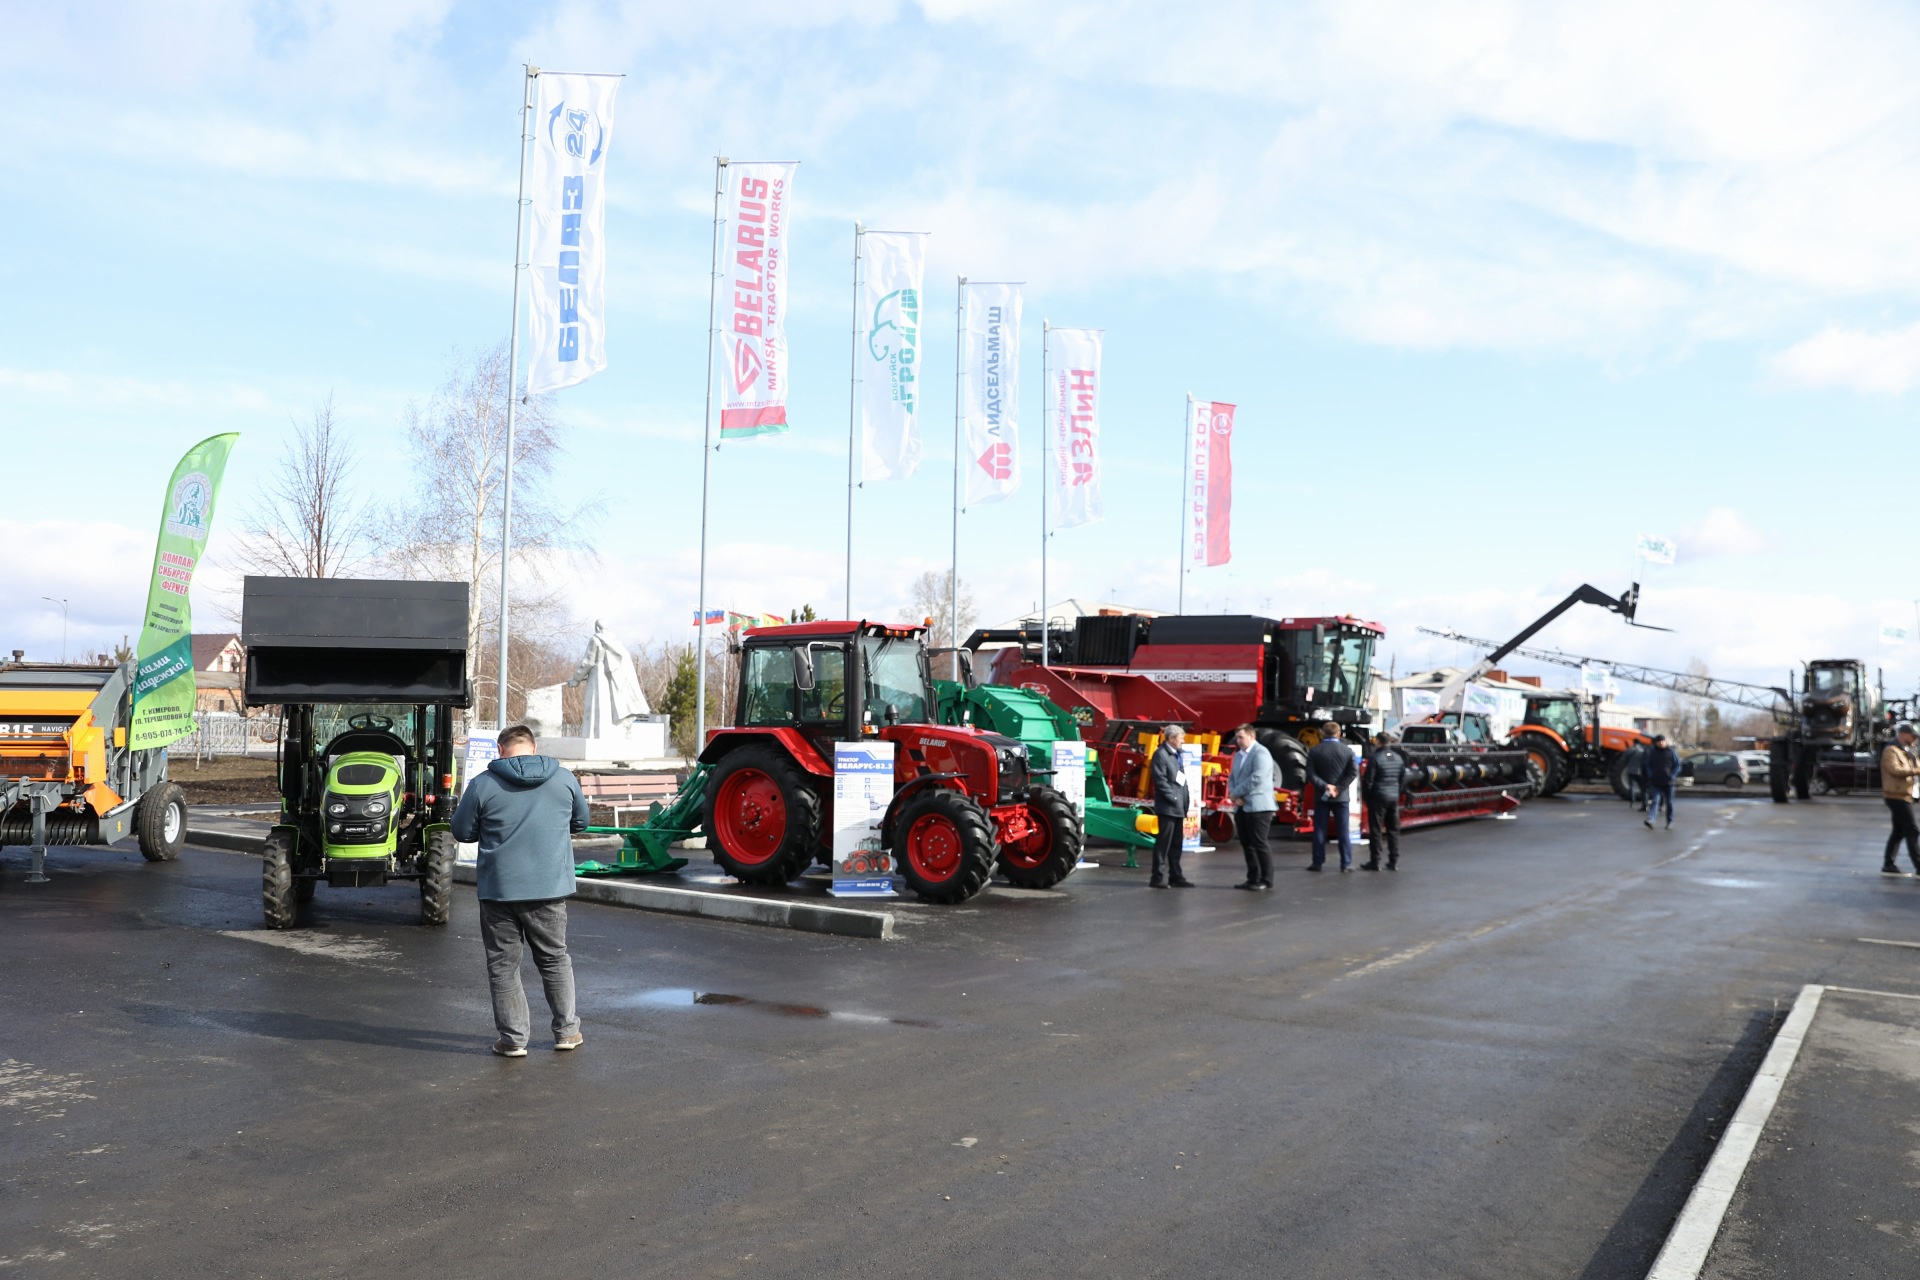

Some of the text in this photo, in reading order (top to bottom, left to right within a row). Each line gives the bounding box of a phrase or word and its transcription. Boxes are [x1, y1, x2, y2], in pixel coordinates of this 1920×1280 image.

[565, 108, 589, 159] 24
[734, 176, 769, 338] BELARUS
[767, 178, 784, 391] MINSK TRACTOR WORKS
[889, 353, 898, 401] БОБРУЙСК
[987, 306, 1002, 437] ЛИДСЕЛЬМАШ
[1059, 446, 1068, 486] ХОЛДИНГ
[161, 581, 189, 595] ФЕРМЕР
[1155, 673, 1229, 683] GOMSELMASH
[144, 711, 183, 725] ТЕРЕШКОВОЙ
[919, 737, 947, 748] BELARUS
